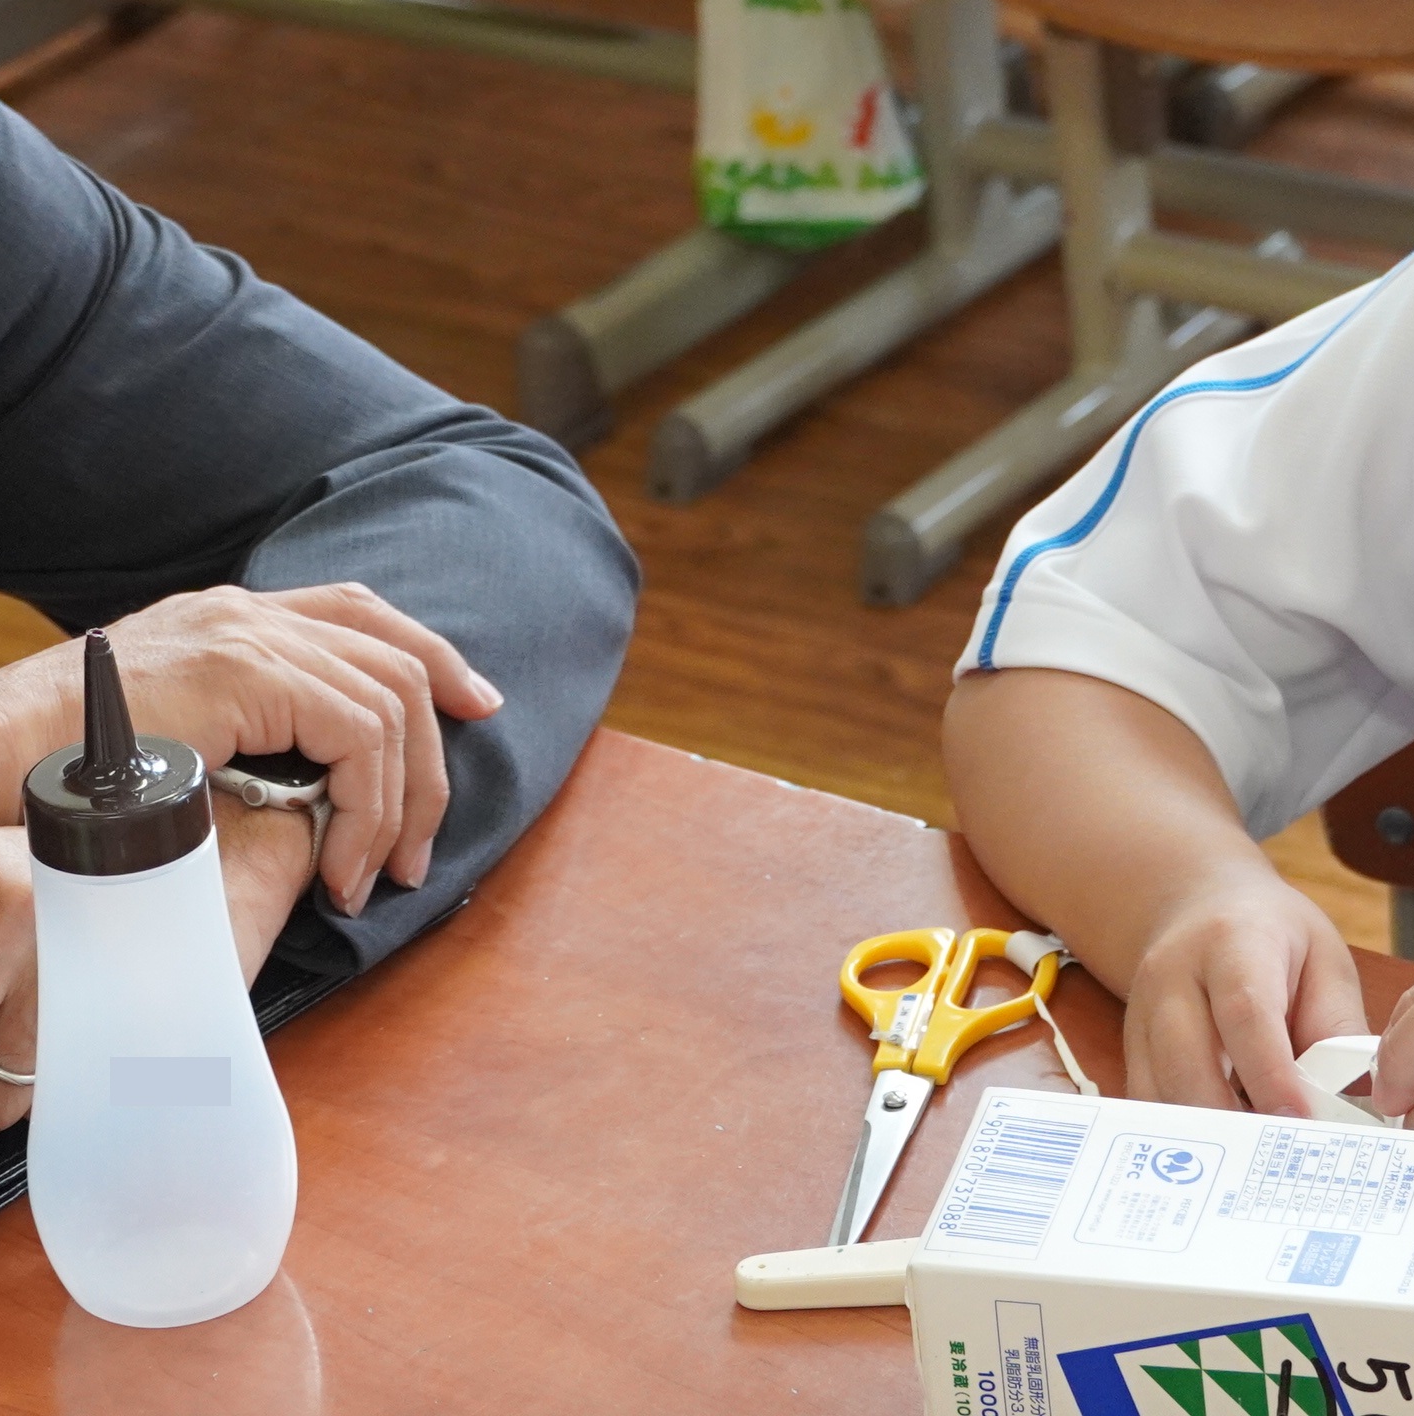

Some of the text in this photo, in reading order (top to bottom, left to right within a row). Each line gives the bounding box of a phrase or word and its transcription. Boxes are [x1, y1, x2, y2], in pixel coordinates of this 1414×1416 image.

[1125, 1143, 1152, 1179] PEFC
[1249, 1131, 1276, 1175] カルシウム
